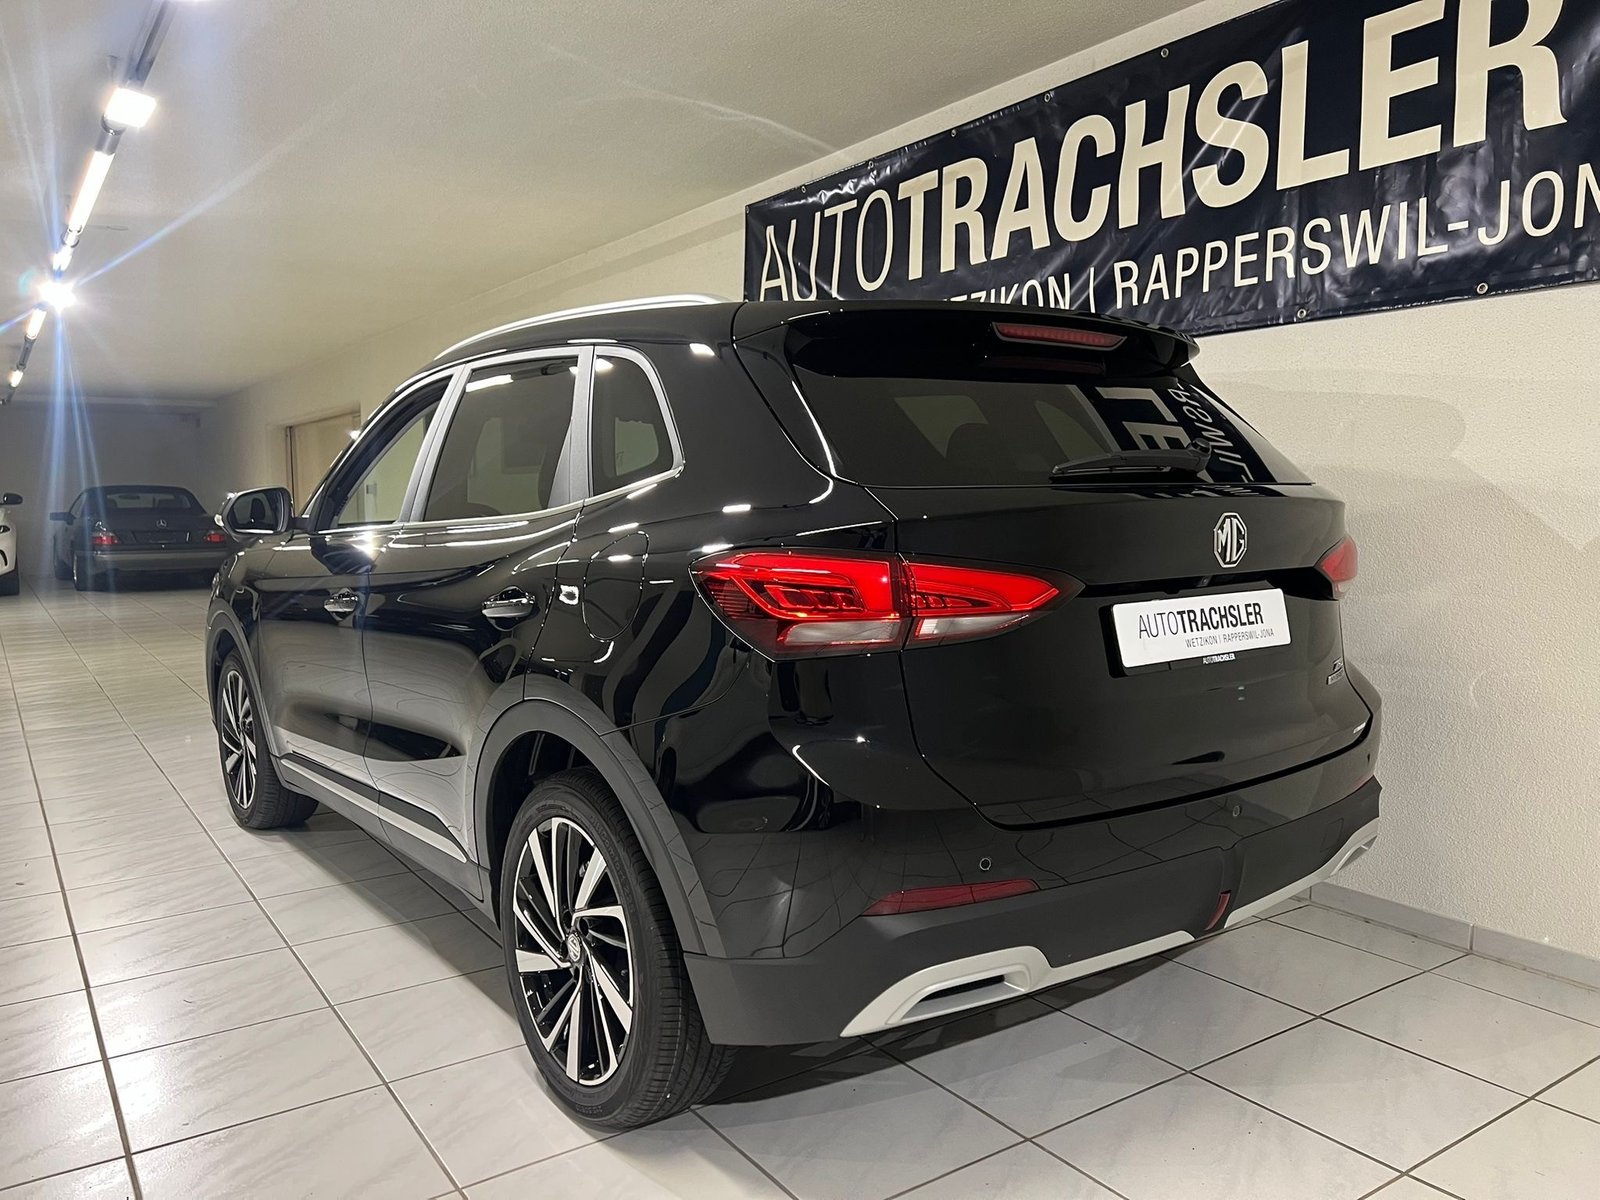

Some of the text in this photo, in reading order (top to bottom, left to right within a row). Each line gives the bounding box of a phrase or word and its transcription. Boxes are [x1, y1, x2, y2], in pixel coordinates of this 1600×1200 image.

[759, 0, 1568, 302] AUTOTRACHSLER
[1216, 516, 1246, 564] MG
[1138, 602, 1264, 639] AUTOTRACHSLER
[1185, 635, 1218, 648] WETZIKON
[1223, 628, 1275, 644] RAPPERSWIL-JONA
